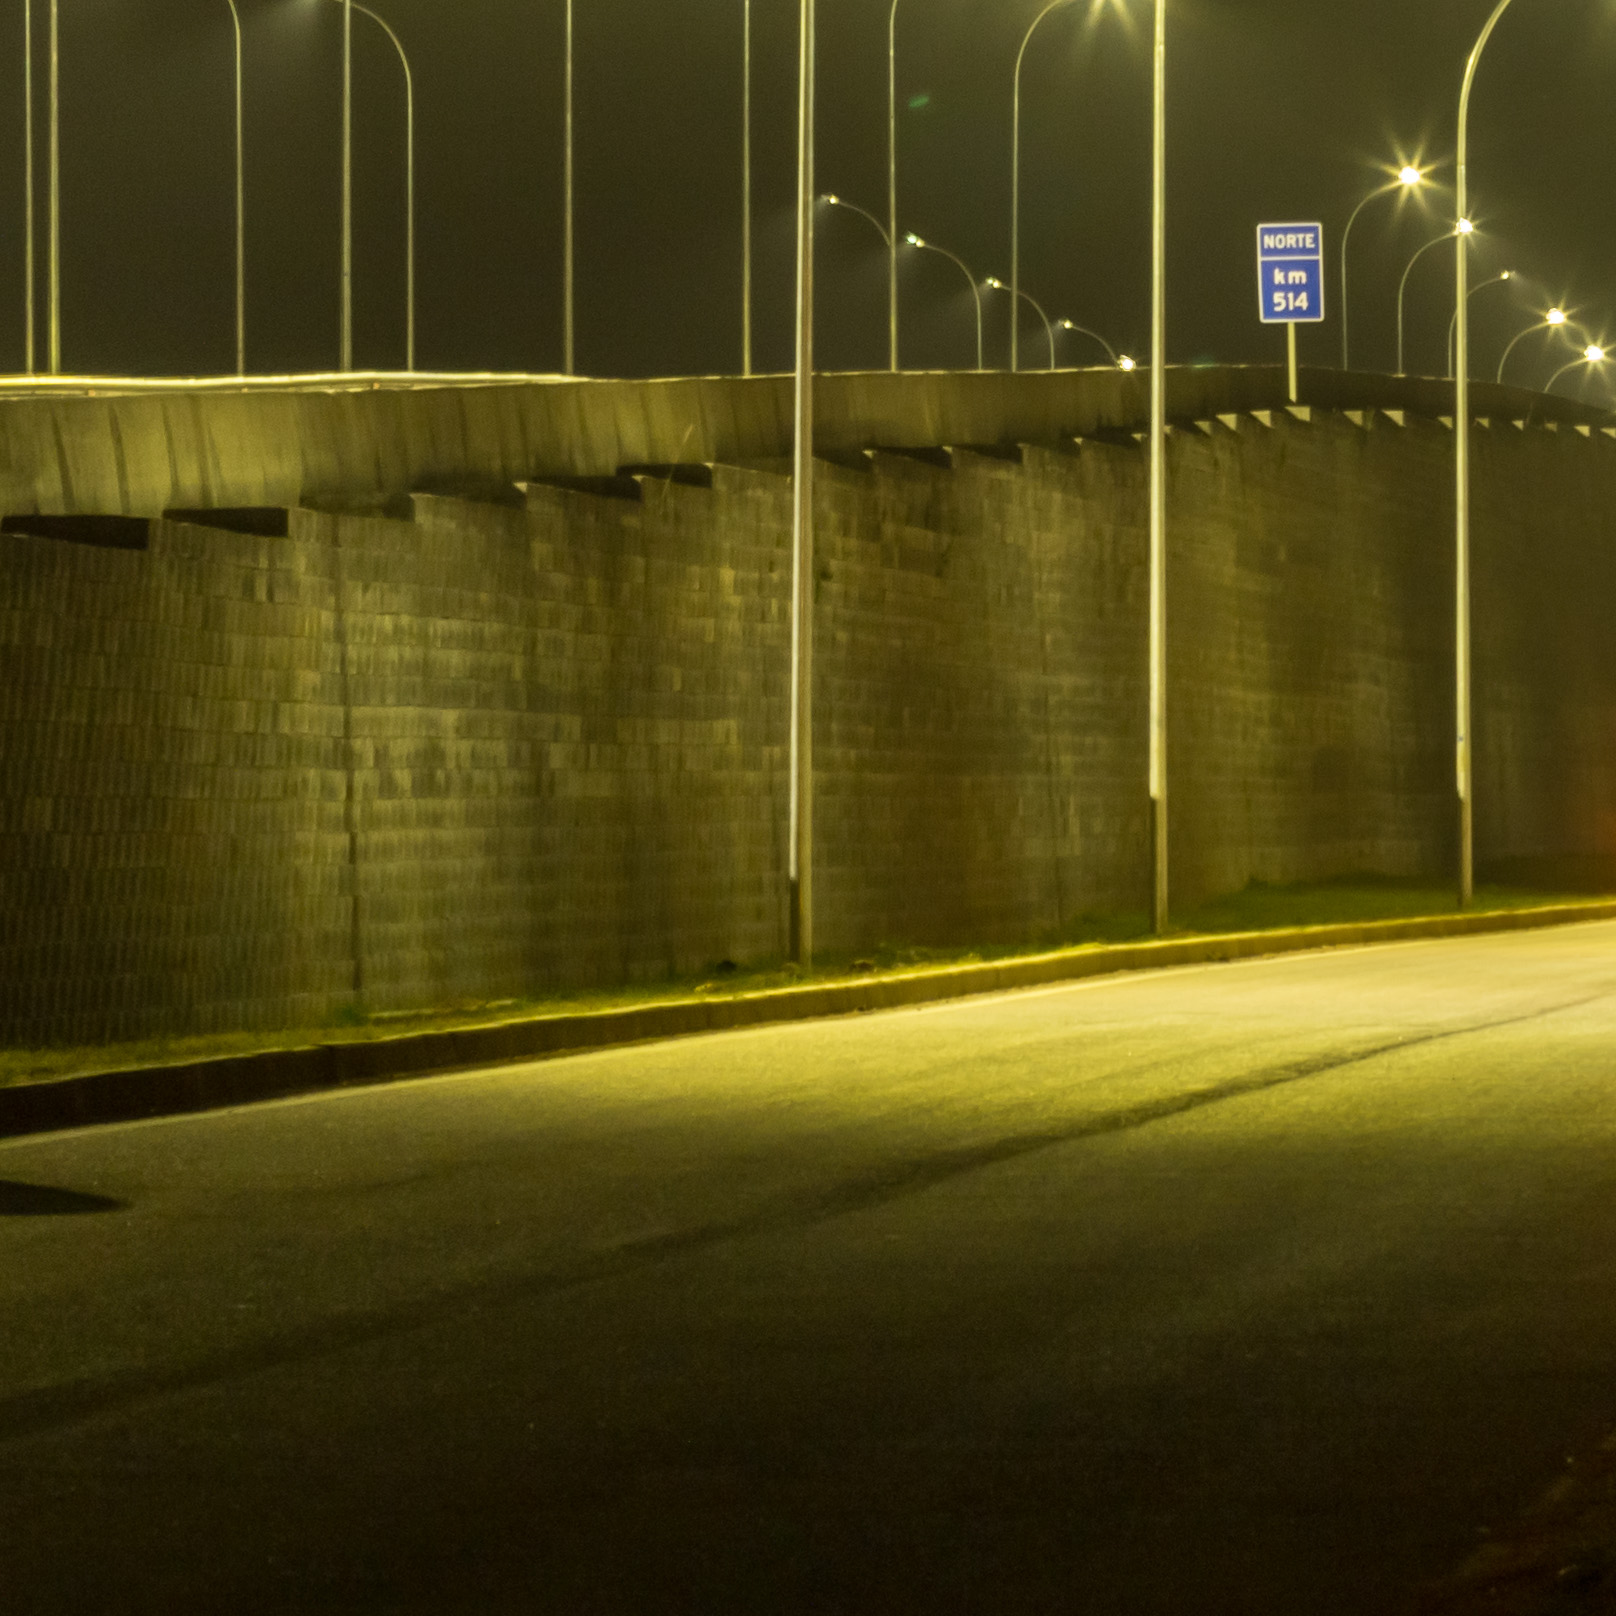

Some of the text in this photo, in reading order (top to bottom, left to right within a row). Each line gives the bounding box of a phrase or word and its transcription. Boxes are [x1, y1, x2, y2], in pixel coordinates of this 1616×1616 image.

[1264, 233, 1315, 249] NORTE
[1273, 267, 1307, 285] km
[1273, 291, 1309, 312] 514
